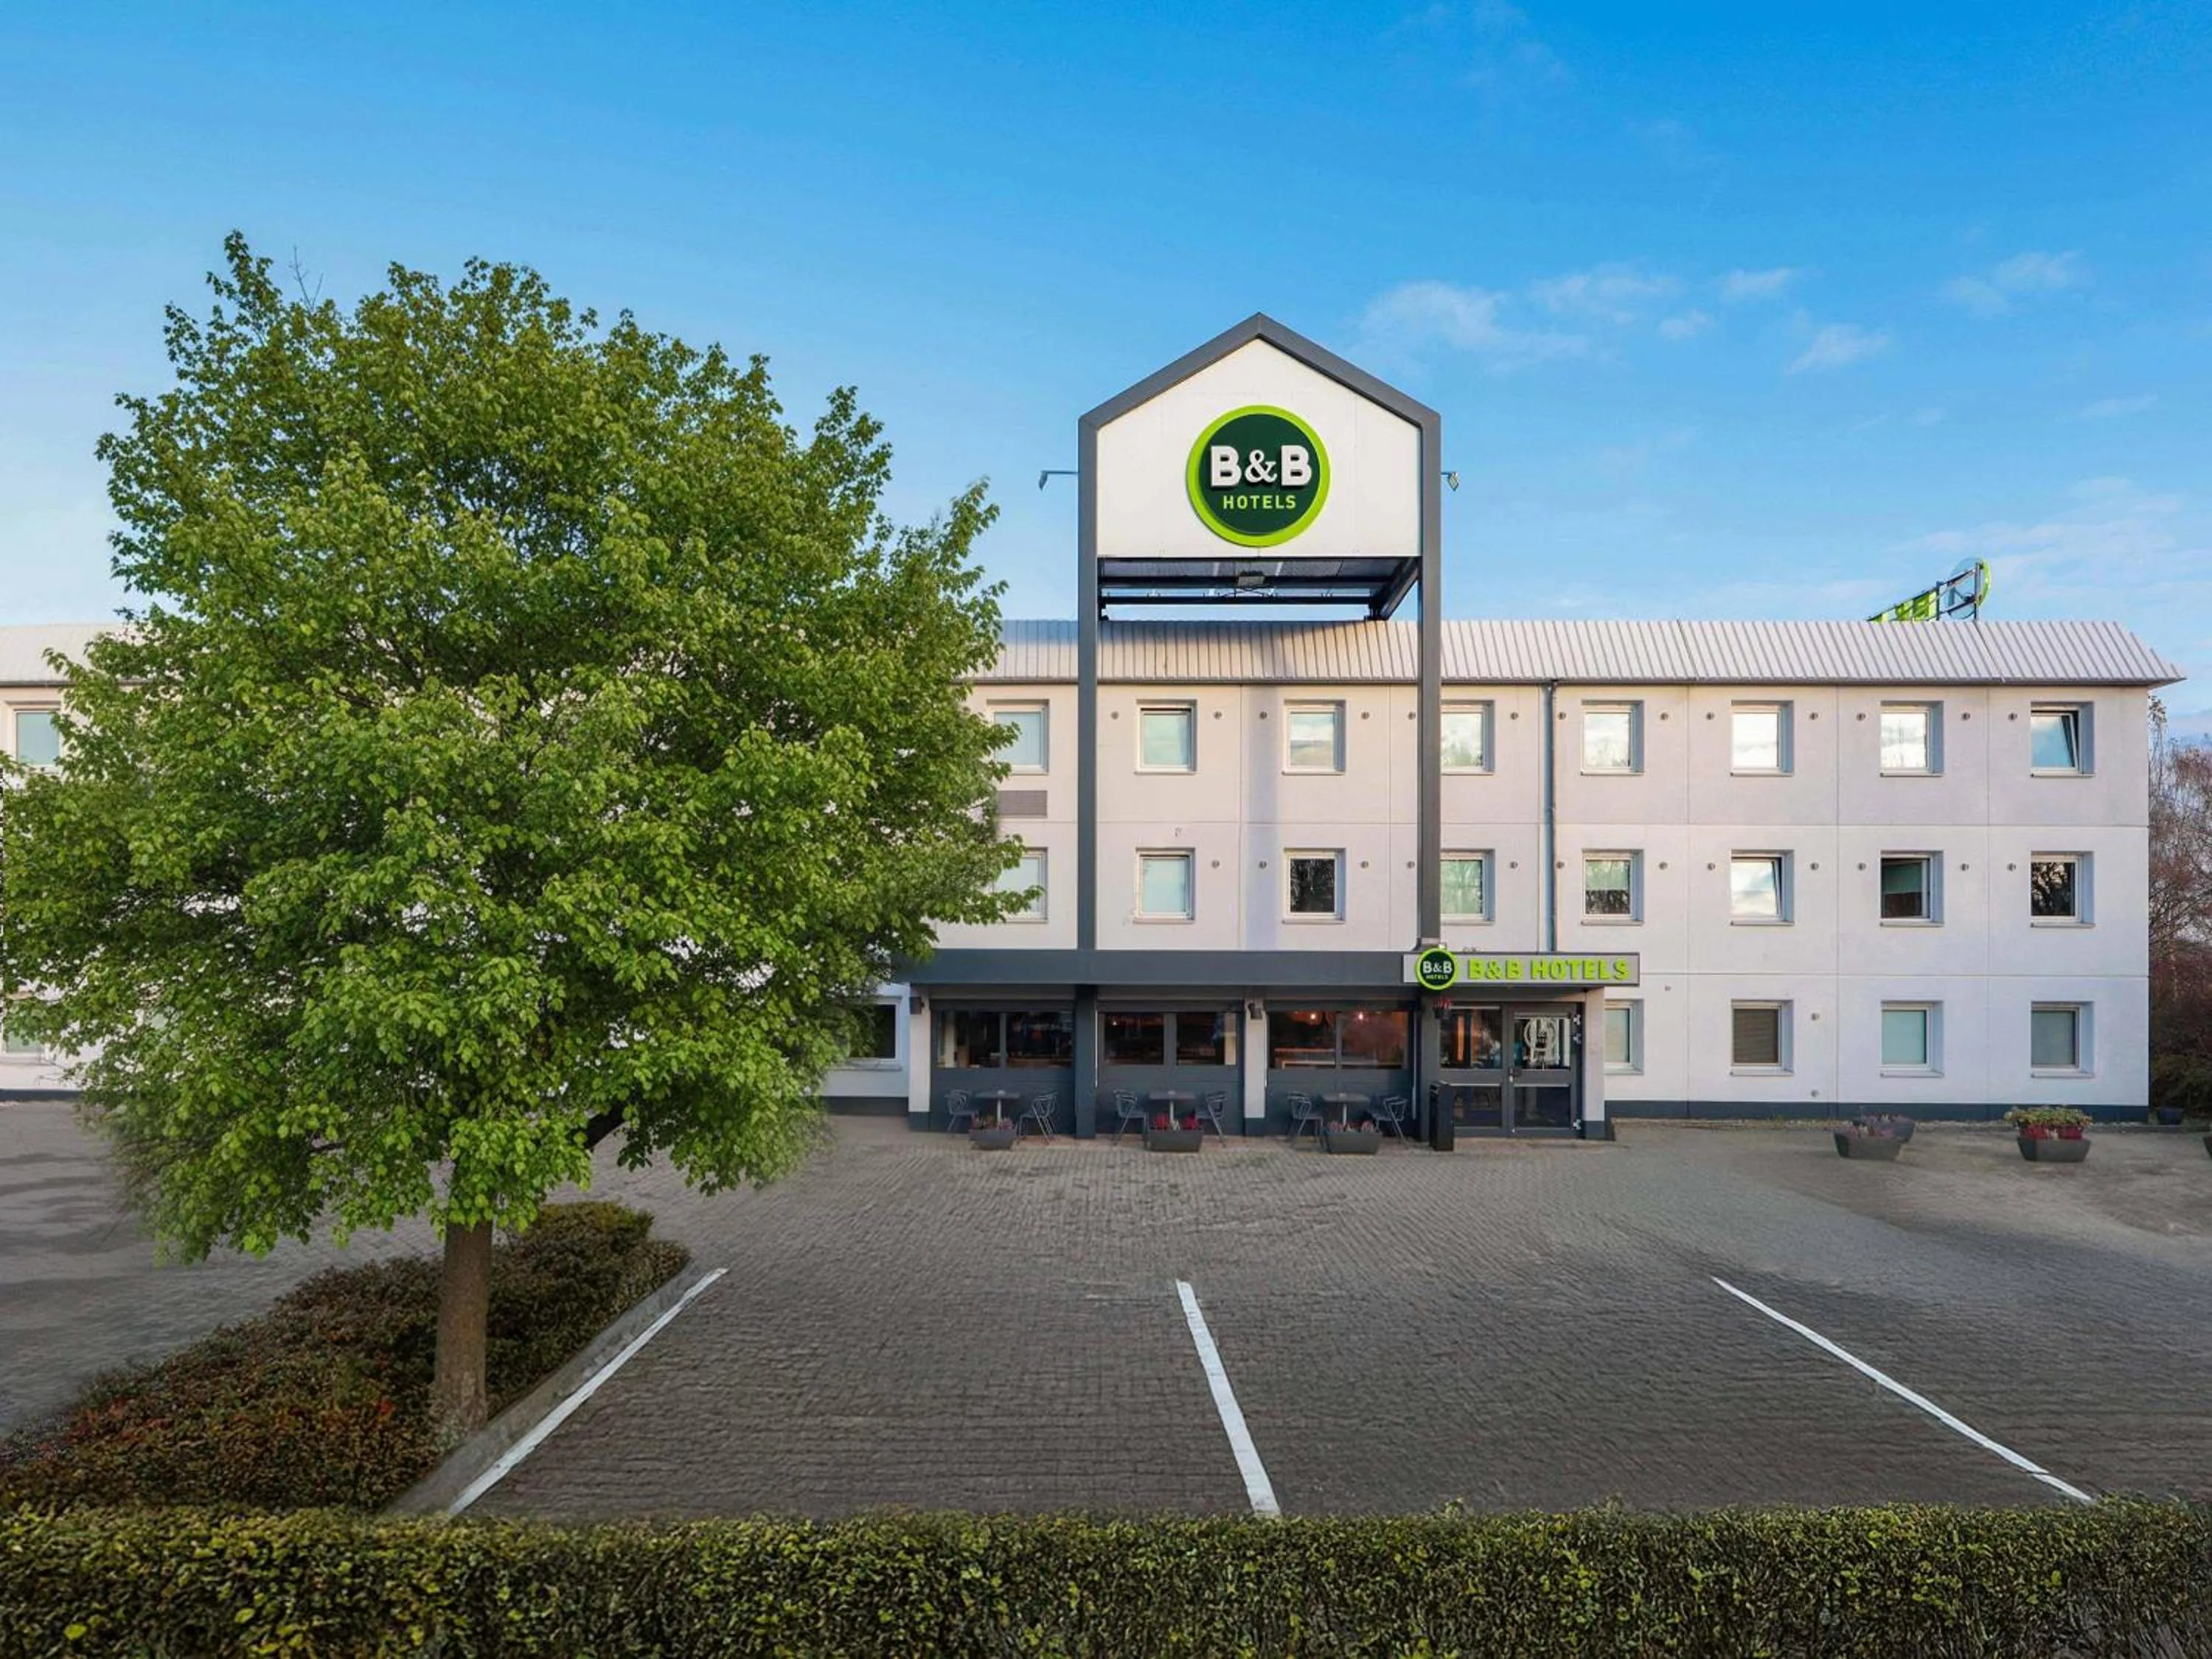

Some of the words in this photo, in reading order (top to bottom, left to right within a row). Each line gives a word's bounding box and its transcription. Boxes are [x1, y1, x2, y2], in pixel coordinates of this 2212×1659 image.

[1211, 445, 1312, 487] B&B
[1222, 495, 1296, 509] HOTELS
[1423, 961, 1453, 973] B&B
[1467, 959, 1523, 979] B&B
[1530, 959, 1630, 980] HOTELS
